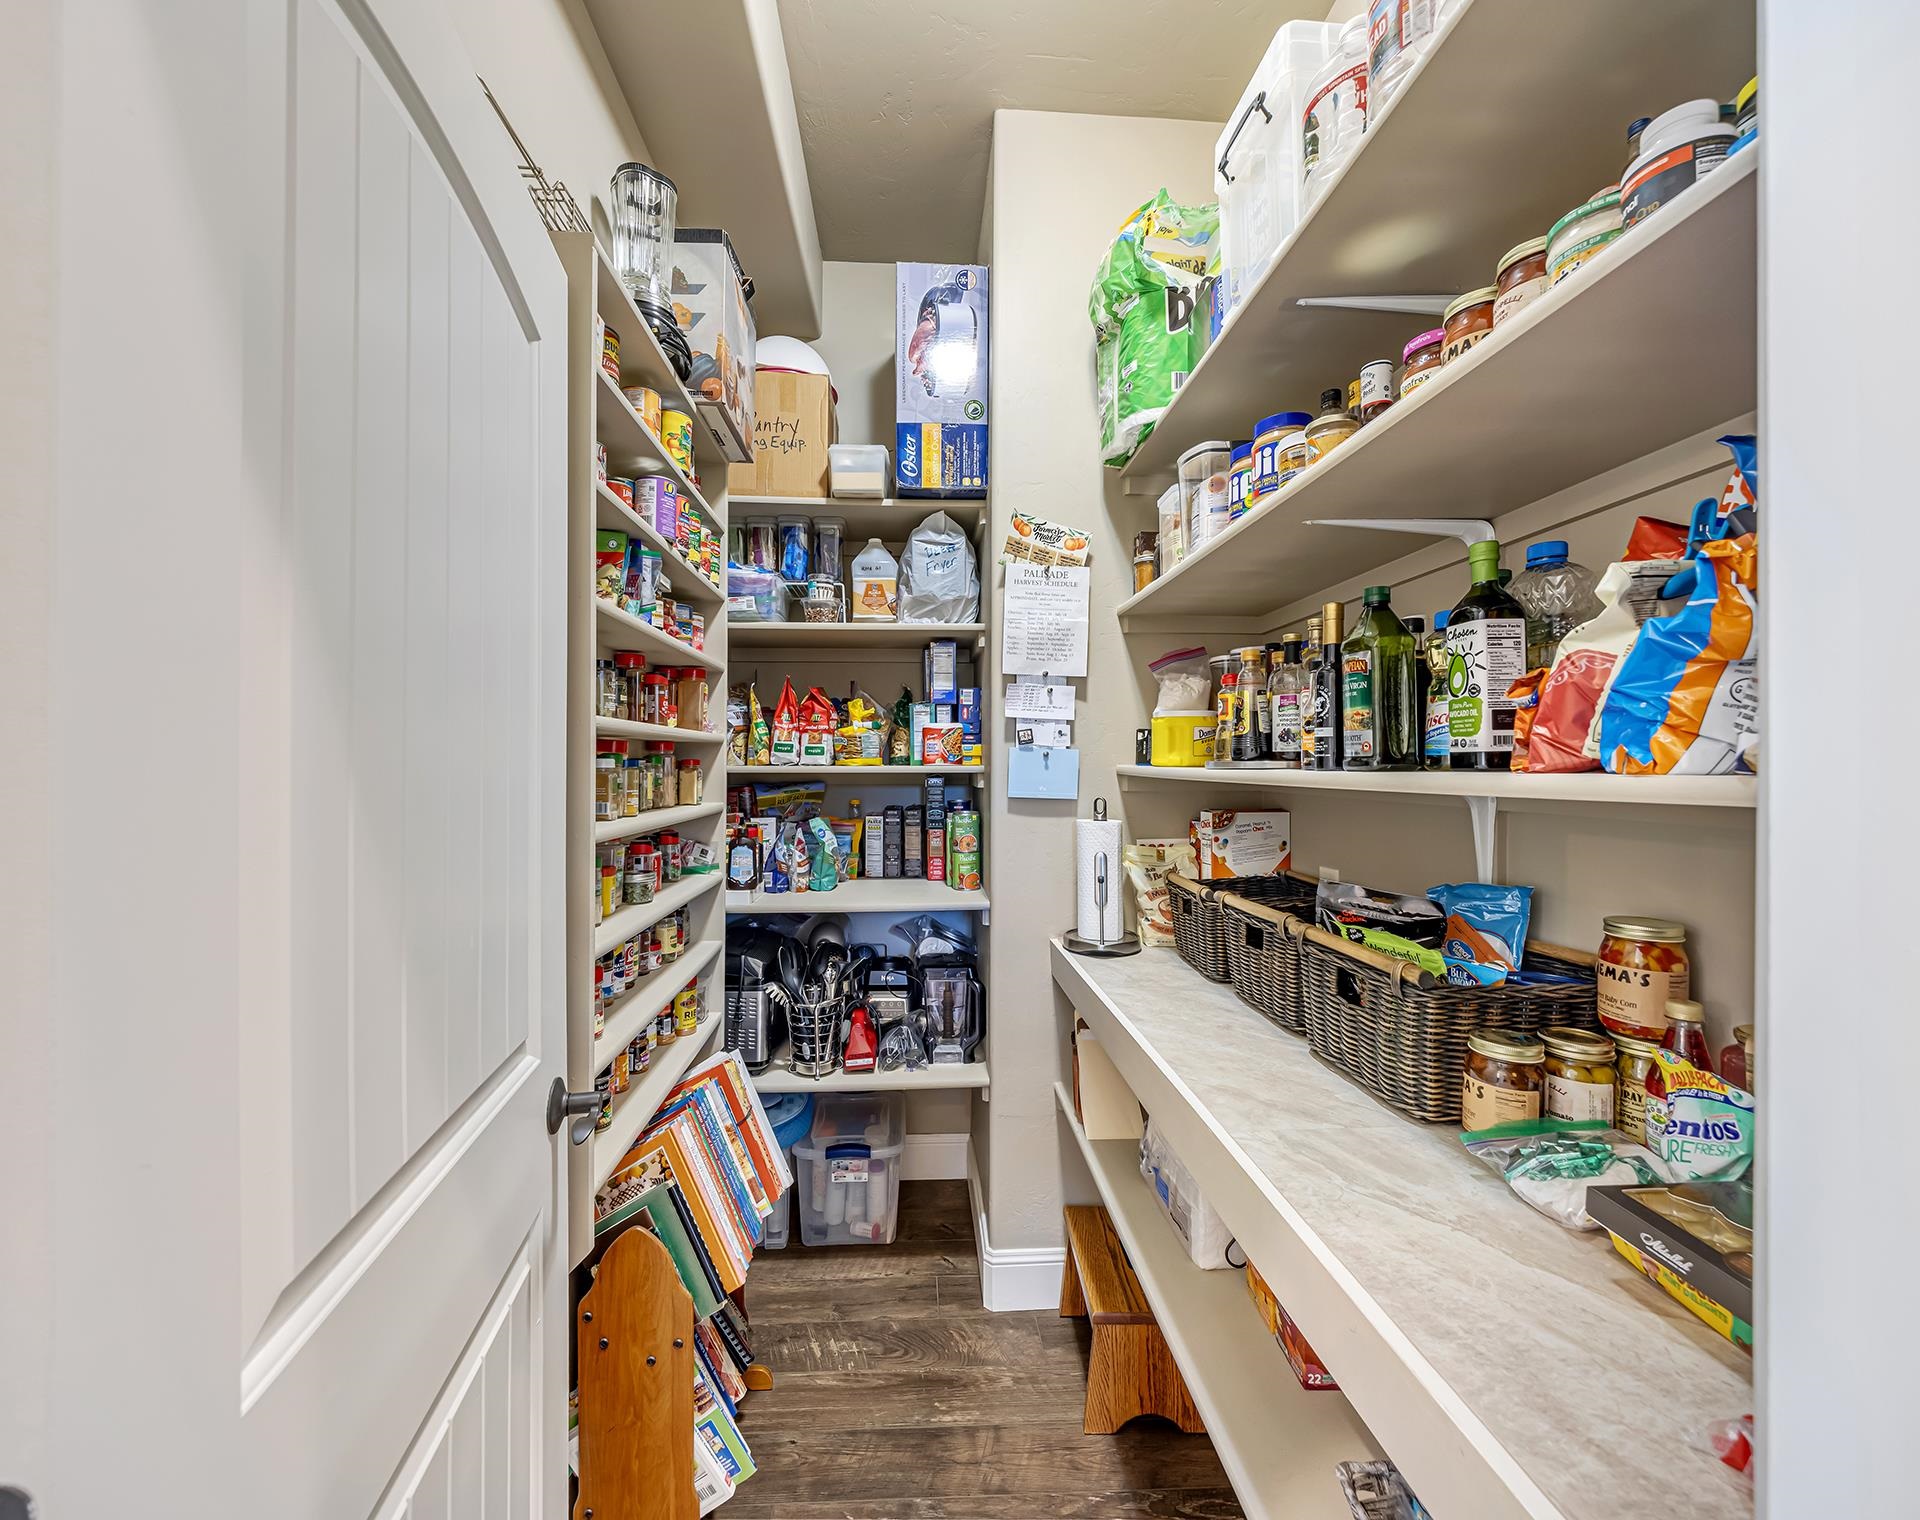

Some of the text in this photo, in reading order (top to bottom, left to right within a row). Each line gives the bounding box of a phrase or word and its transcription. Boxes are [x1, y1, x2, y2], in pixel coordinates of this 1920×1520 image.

[754, 411, 800, 450] antry
[771, 436, 807, 454] Equip.
[901, 433, 918, 477] Oster
[931, 427, 940, 484] Roaster Oven
[926, 557, 958, 576] Fryer
[1024, 569, 1070, 579] PALISADE
[1043, 580, 1078, 588] SCHEDULE
[1447, 628, 1478, 643] Chosen
[1365, 942, 1421, 965] Wonderful
[1450, 967, 1469, 980] BLUE
[1604, 993, 1638, 1009] Baby Corn
[1665, 1118, 1741, 1141] entos
[1694, 1142, 1738, 1158] FRESH
[1307, 1373, 1322, 1385] 22
